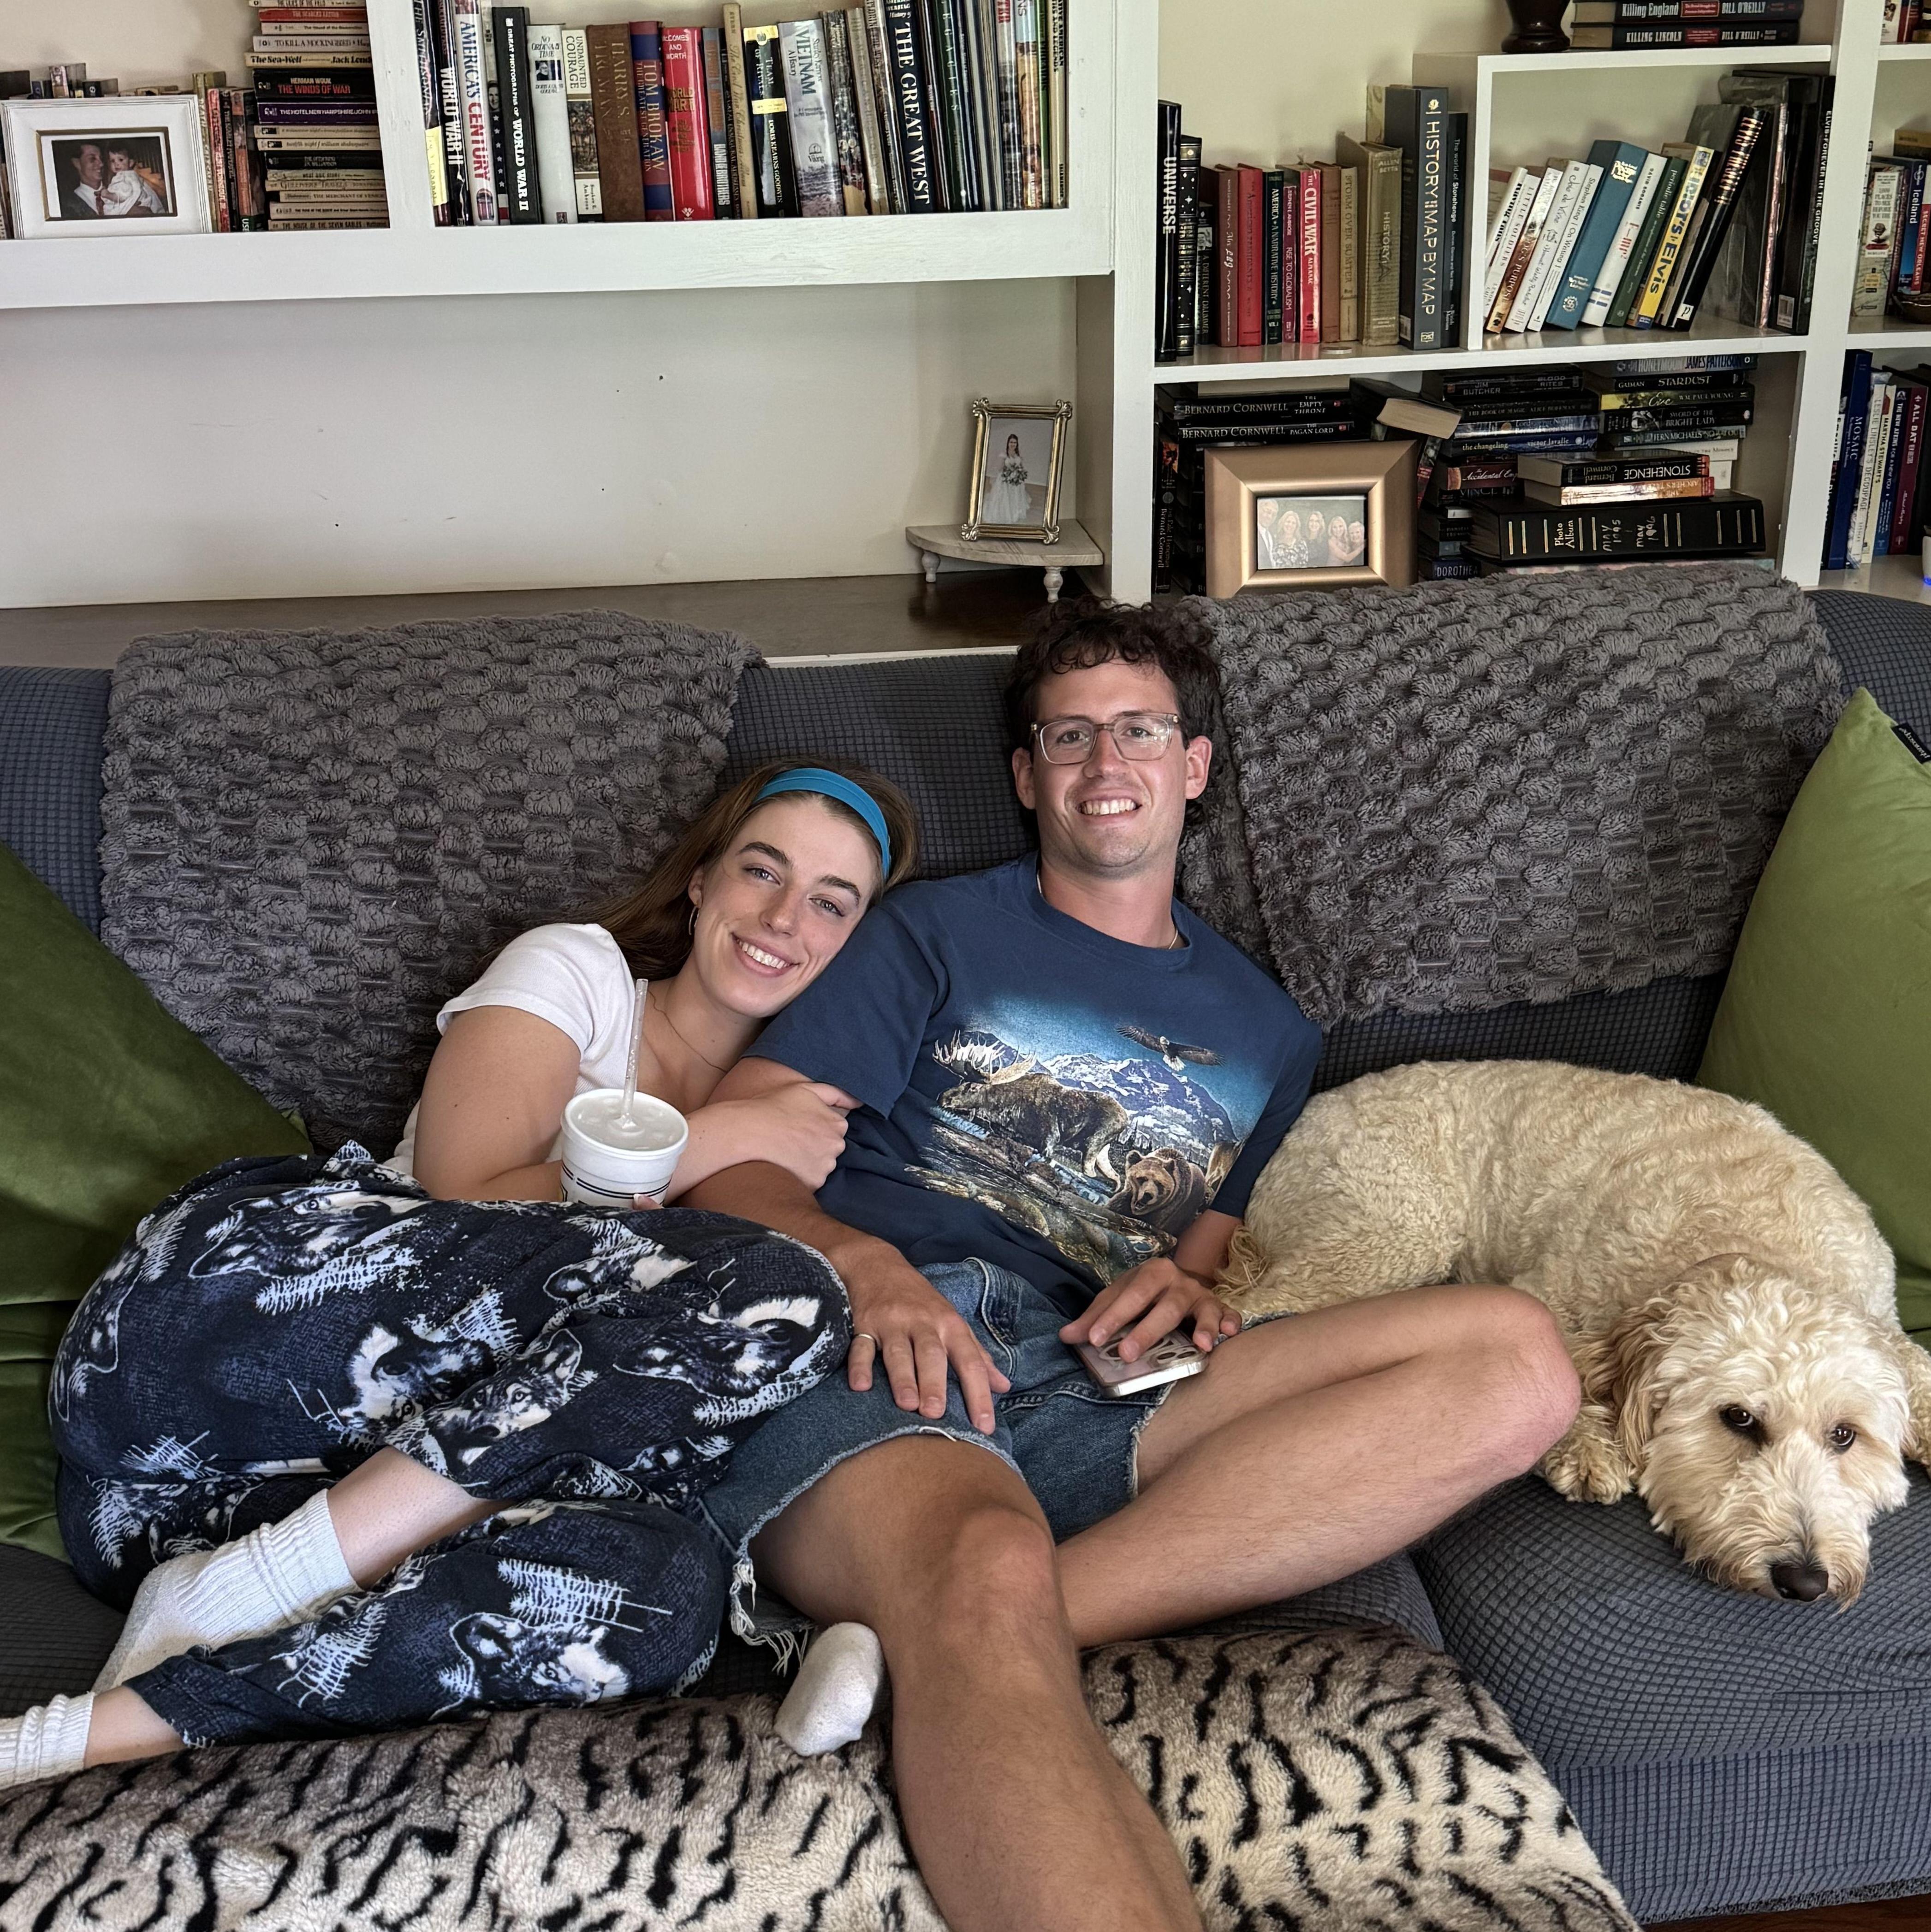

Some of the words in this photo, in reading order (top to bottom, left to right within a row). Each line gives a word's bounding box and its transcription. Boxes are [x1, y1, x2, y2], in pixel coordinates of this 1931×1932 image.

[1622, 4, 1646, 18] Killing
[1648, 2, 1679, 17] England
[1722, 3, 1736, 14] BILL
[1737, 1, 1766, 13] O'REILLY
[894, 22, 915, 68] THE
[1626, 32, 1653, 42] KILLING
[1655, 31, 1682, 42] LINCOLN
[1722, 31, 1734, 40] BILL
[460, 21, 480, 99] AMERICA'S
[566, 36, 579, 89] COURAGE
[576, 36, 587, 88] UNDAUNTED
[611, 42, 629, 99] HARRY
[765, 57, 774, 86] TEAM
[795, 28, 816, 95] VIETNAM
[295, 85, 320, 94] WINDS
[321, 85, 331, 94] OF
[333, 85, 351, 94] WAR
[440, 66, 457, 116] WORLD
[509, 54, 519, 105] PHOTOGRAPHS
[643, 61, 658, 95] TOM
[513, 107, 519, 117] OF
[637, 79, 647, 120] GREATEST
[900, 73, 923, 141] GREAT
[445, 120, 460, 152] WAR
[468, 102, 490, 182] CENTURY
[512, 119, 525, 166] WORLD
[641, 122, 652, 172] GENERATION
[646, 102, 665, 171] BROKAW
[447, 154, 463, 165] II
[770, 141, 780, 169] KEARNS
[1425, 121, 1440, 198] HISTORY
[1819, 138, 1829, 177] FOREVER
[517, 169, 528, 198] WAR
[774, 170, 783, 203] GOODWIN
[909, 145, 930, 204] WEST
[1661, 170, 1678, 200] periodic
[1818, 179, 1824, 189] IN
[519, 200, 529, 211] II
[1163, 157, 1176, 234] UNIVERSE
[1304, 188, 1317, 222] CIVIL
[1344, 175, 1353, 210] STORM
[1450, 181, 1460, 223] Stonehenge
[1519, 187, 1534, 219] LITTLE
[1580, 178, 1596, 207] Stephen
[1657, 199, 1667, 218] table
[1909, 190, 1922, 224] Iceland
[1344, 213, 1353, 240] OVER
[1424, 209, 1438, 249] MAP
[1573, 206, 1585, 221] King
[1812, 210, 1821, 245] GROOVE
[1304, 223, 1317, 256] WAR
[1382, 212, 1391, 261] HISTORY
[1286, 261, 1292, 271] TO
[1344, 243, 1353, 283] SUMTER
[1423, 252, 1437, 275] BY
[1650, 243, 1677, 294] Elvis
[1913, 255, 1922, 285] ORLEANS
[1421, 278, 1437, 315] MAP
[1685, 357, 1706, 369] JAMES
[1658, 376, 1712, 386] STARDUST
[1184, 405, 1230, 414] BERNARD
[1233, 403, 1288, 413] CORNWELL
[1649, 392, 1674, 406] Eve
[1872, 399, 1882, 425] LESLIE
[1912, 404, 1920, 422] ALL
[1182, 429, 1228, 438] BERNARD
[1231, 427, 1285, 436] CORNWELL
[1666, 418, 1694, 427] BRIGHT
[1850, 416, 1863, 461] MOSAIC
[1880, 417, 1889, 445] MARTHA
[1474, 442, 1509, 450] changeling
[1866, 427, 1878, 463] LINSLEY'S
[1584, 465, 1617, 475] Cornwell
[1585, 474, 1615, 483] Bernard
[1624, 465, 1690, 480] STONEHENGE
[1875, 447, 1884, 483] STEWART'S
[1860, 467, 1872, 511] DECOUPAGE
[1555, 523, 1564, 546] Photo
[1565, 520, 1575, 549] Album
